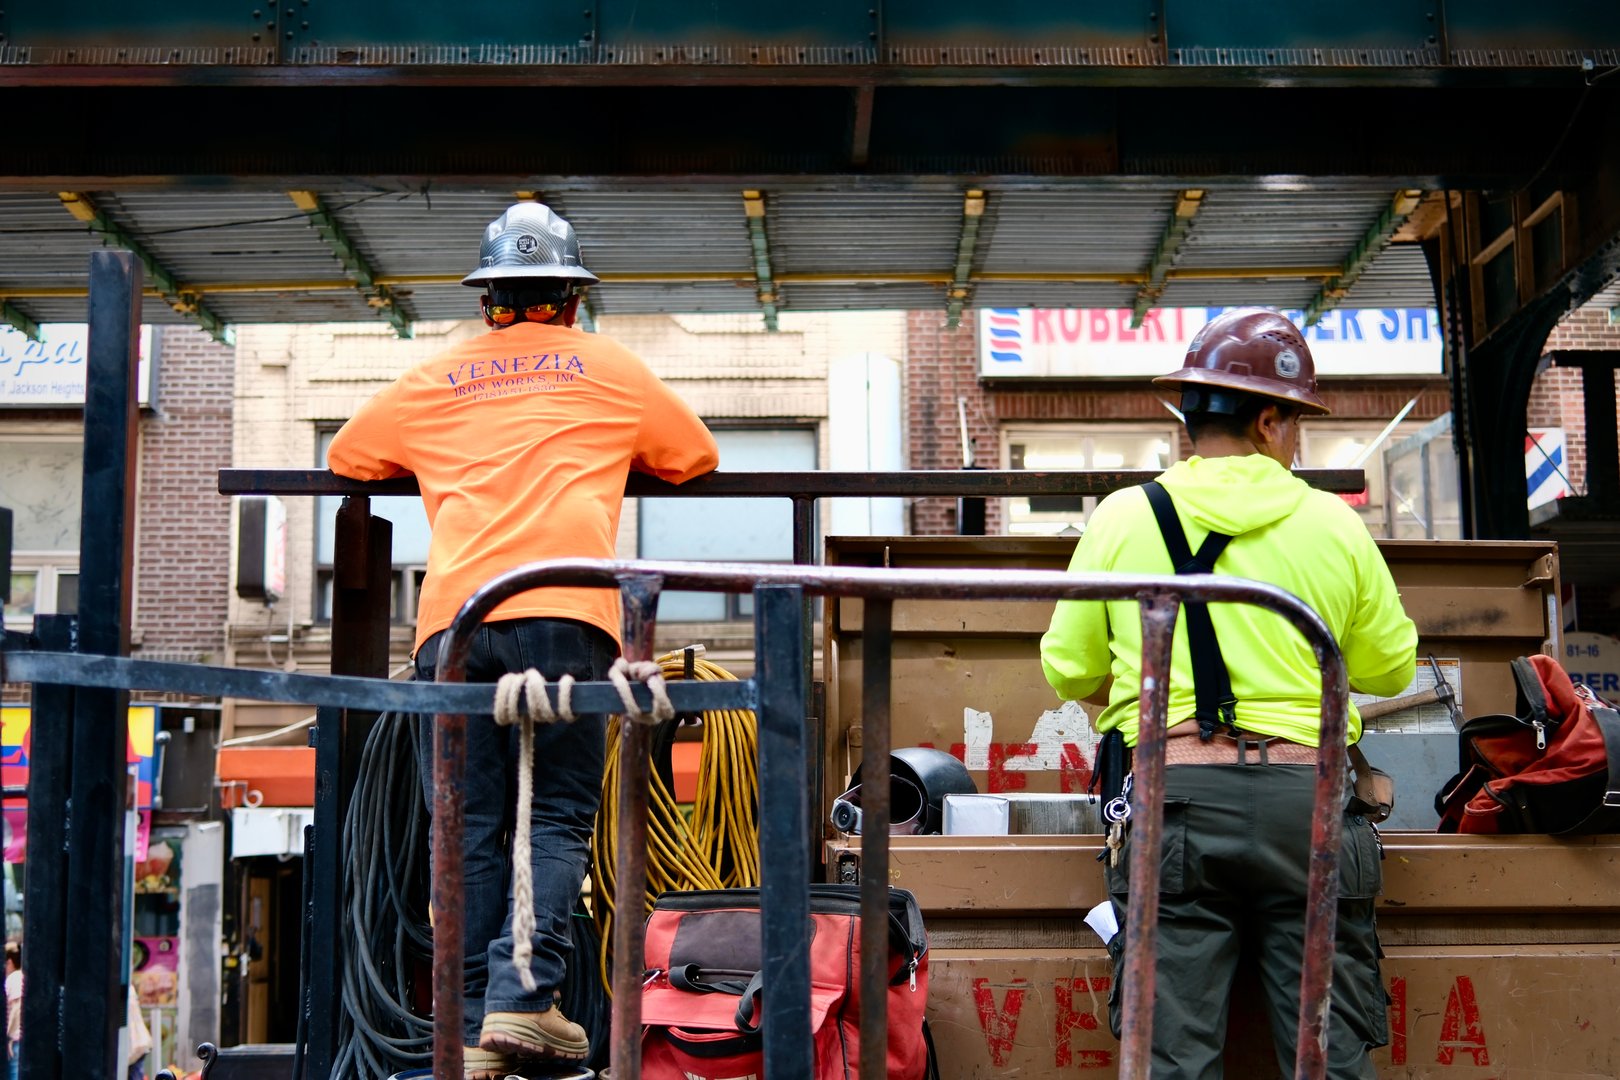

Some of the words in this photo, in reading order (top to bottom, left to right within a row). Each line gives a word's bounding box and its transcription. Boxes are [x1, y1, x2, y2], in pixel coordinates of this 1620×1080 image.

[447, 353, 585, 386] VENEZIA
[9, 381, 48, 395] Jackson
[454, 383, 486, 397] IRON
[491, 374, 551, 389] WORKS,
